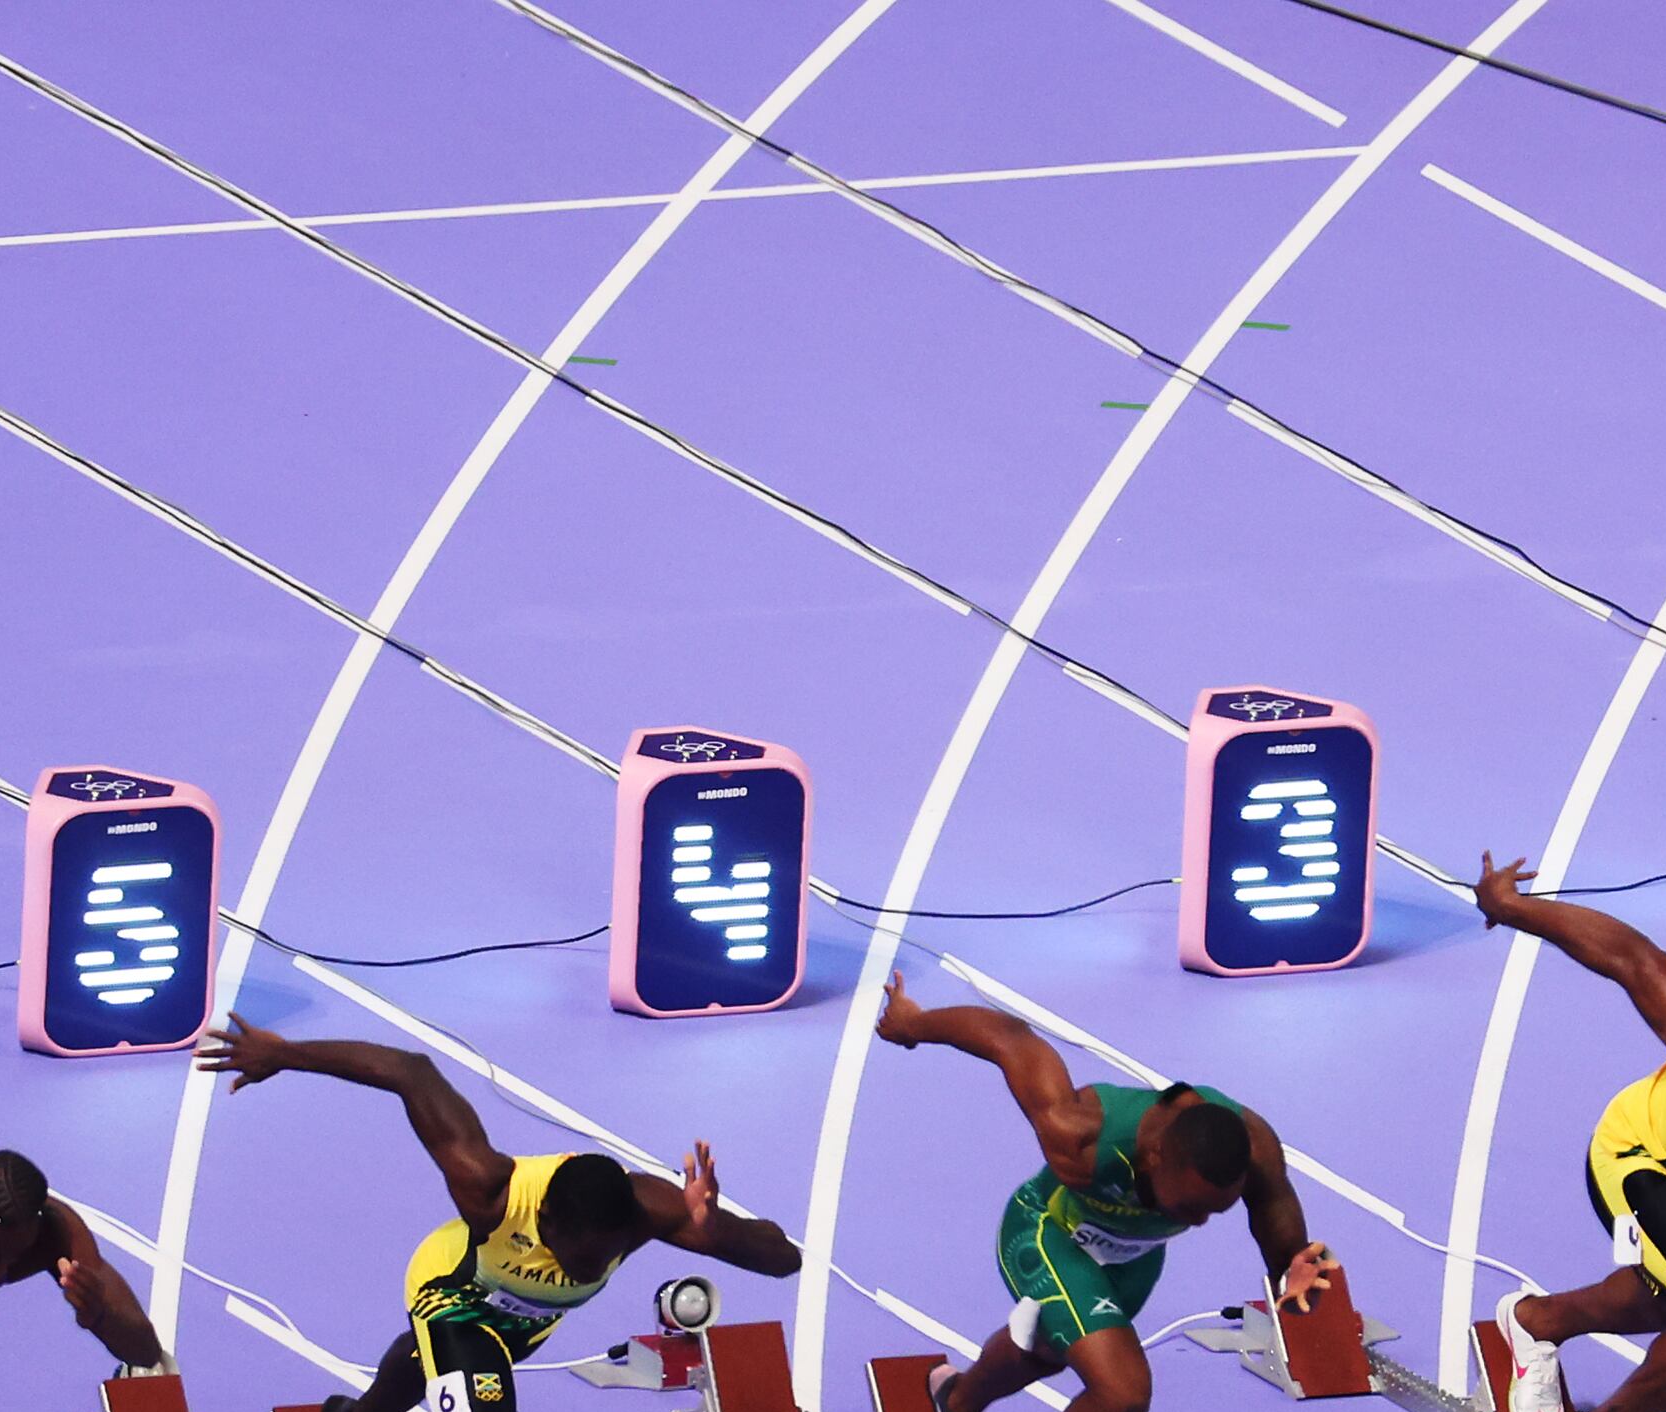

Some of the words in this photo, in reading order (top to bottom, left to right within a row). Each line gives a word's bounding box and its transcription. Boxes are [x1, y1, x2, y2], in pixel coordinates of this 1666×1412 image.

[1275, 743, 1317, 755] MONDO
[116, 822, 158, 834] MONDO
[706, 787, 748, 799] MONDO
[1231, 780, 1340, 921] 3
[671, 825, 771, 960] 4
[75, 862, 179, 1005] 5
